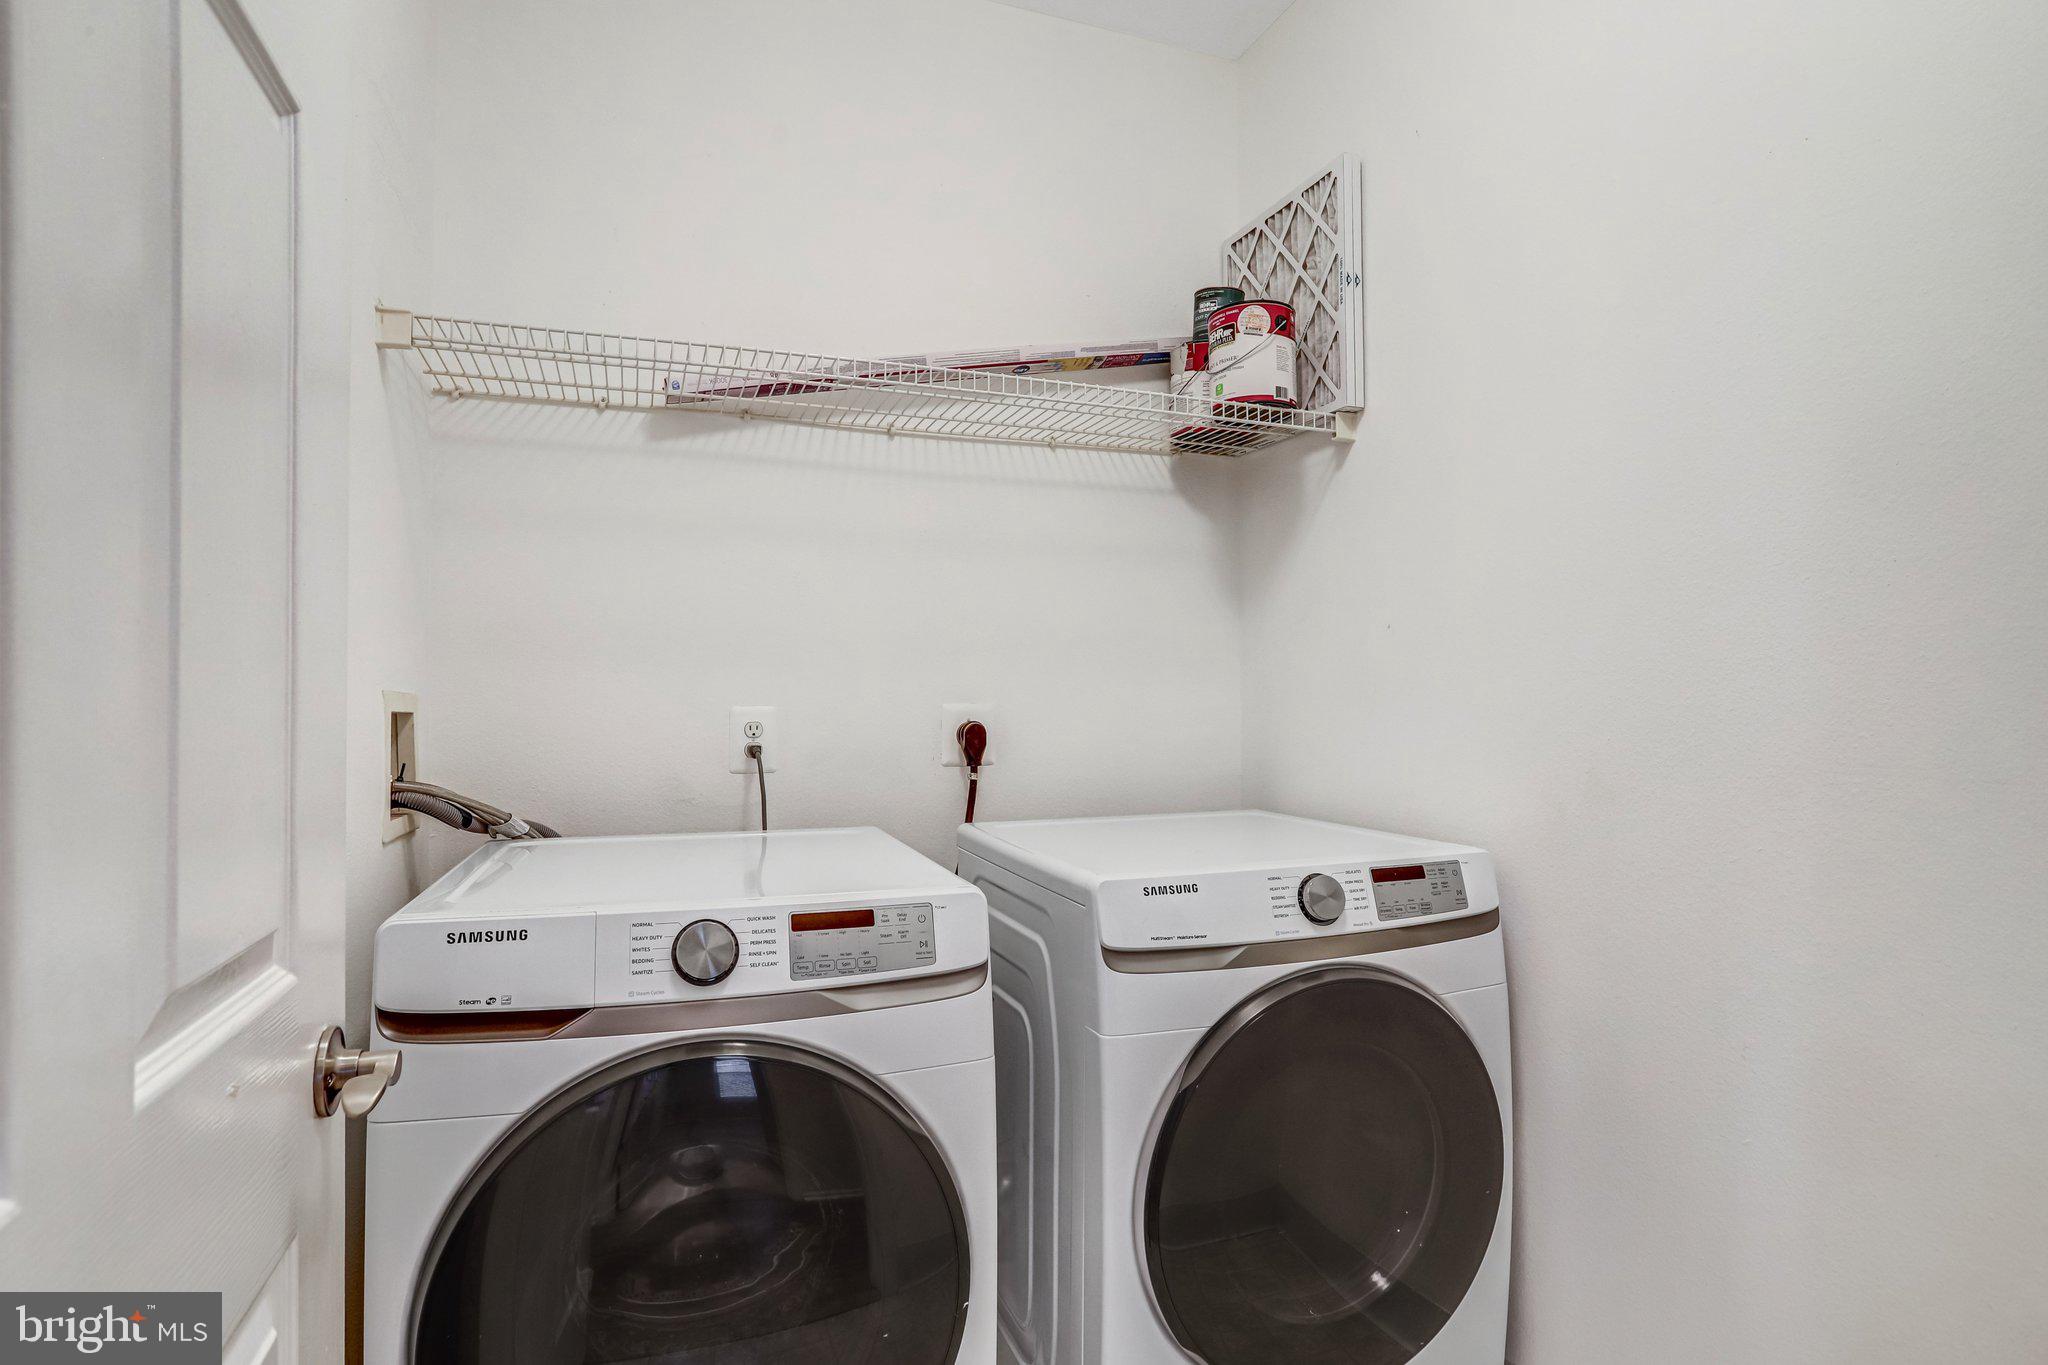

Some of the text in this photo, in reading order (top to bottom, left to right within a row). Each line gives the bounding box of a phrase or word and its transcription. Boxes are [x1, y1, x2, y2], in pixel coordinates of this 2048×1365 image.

[1143, 883, 1198, 897] SAMSUNG
[446, 929, 528, 944] SAMSUNG
[458, 998, 481, 1006] Steam
